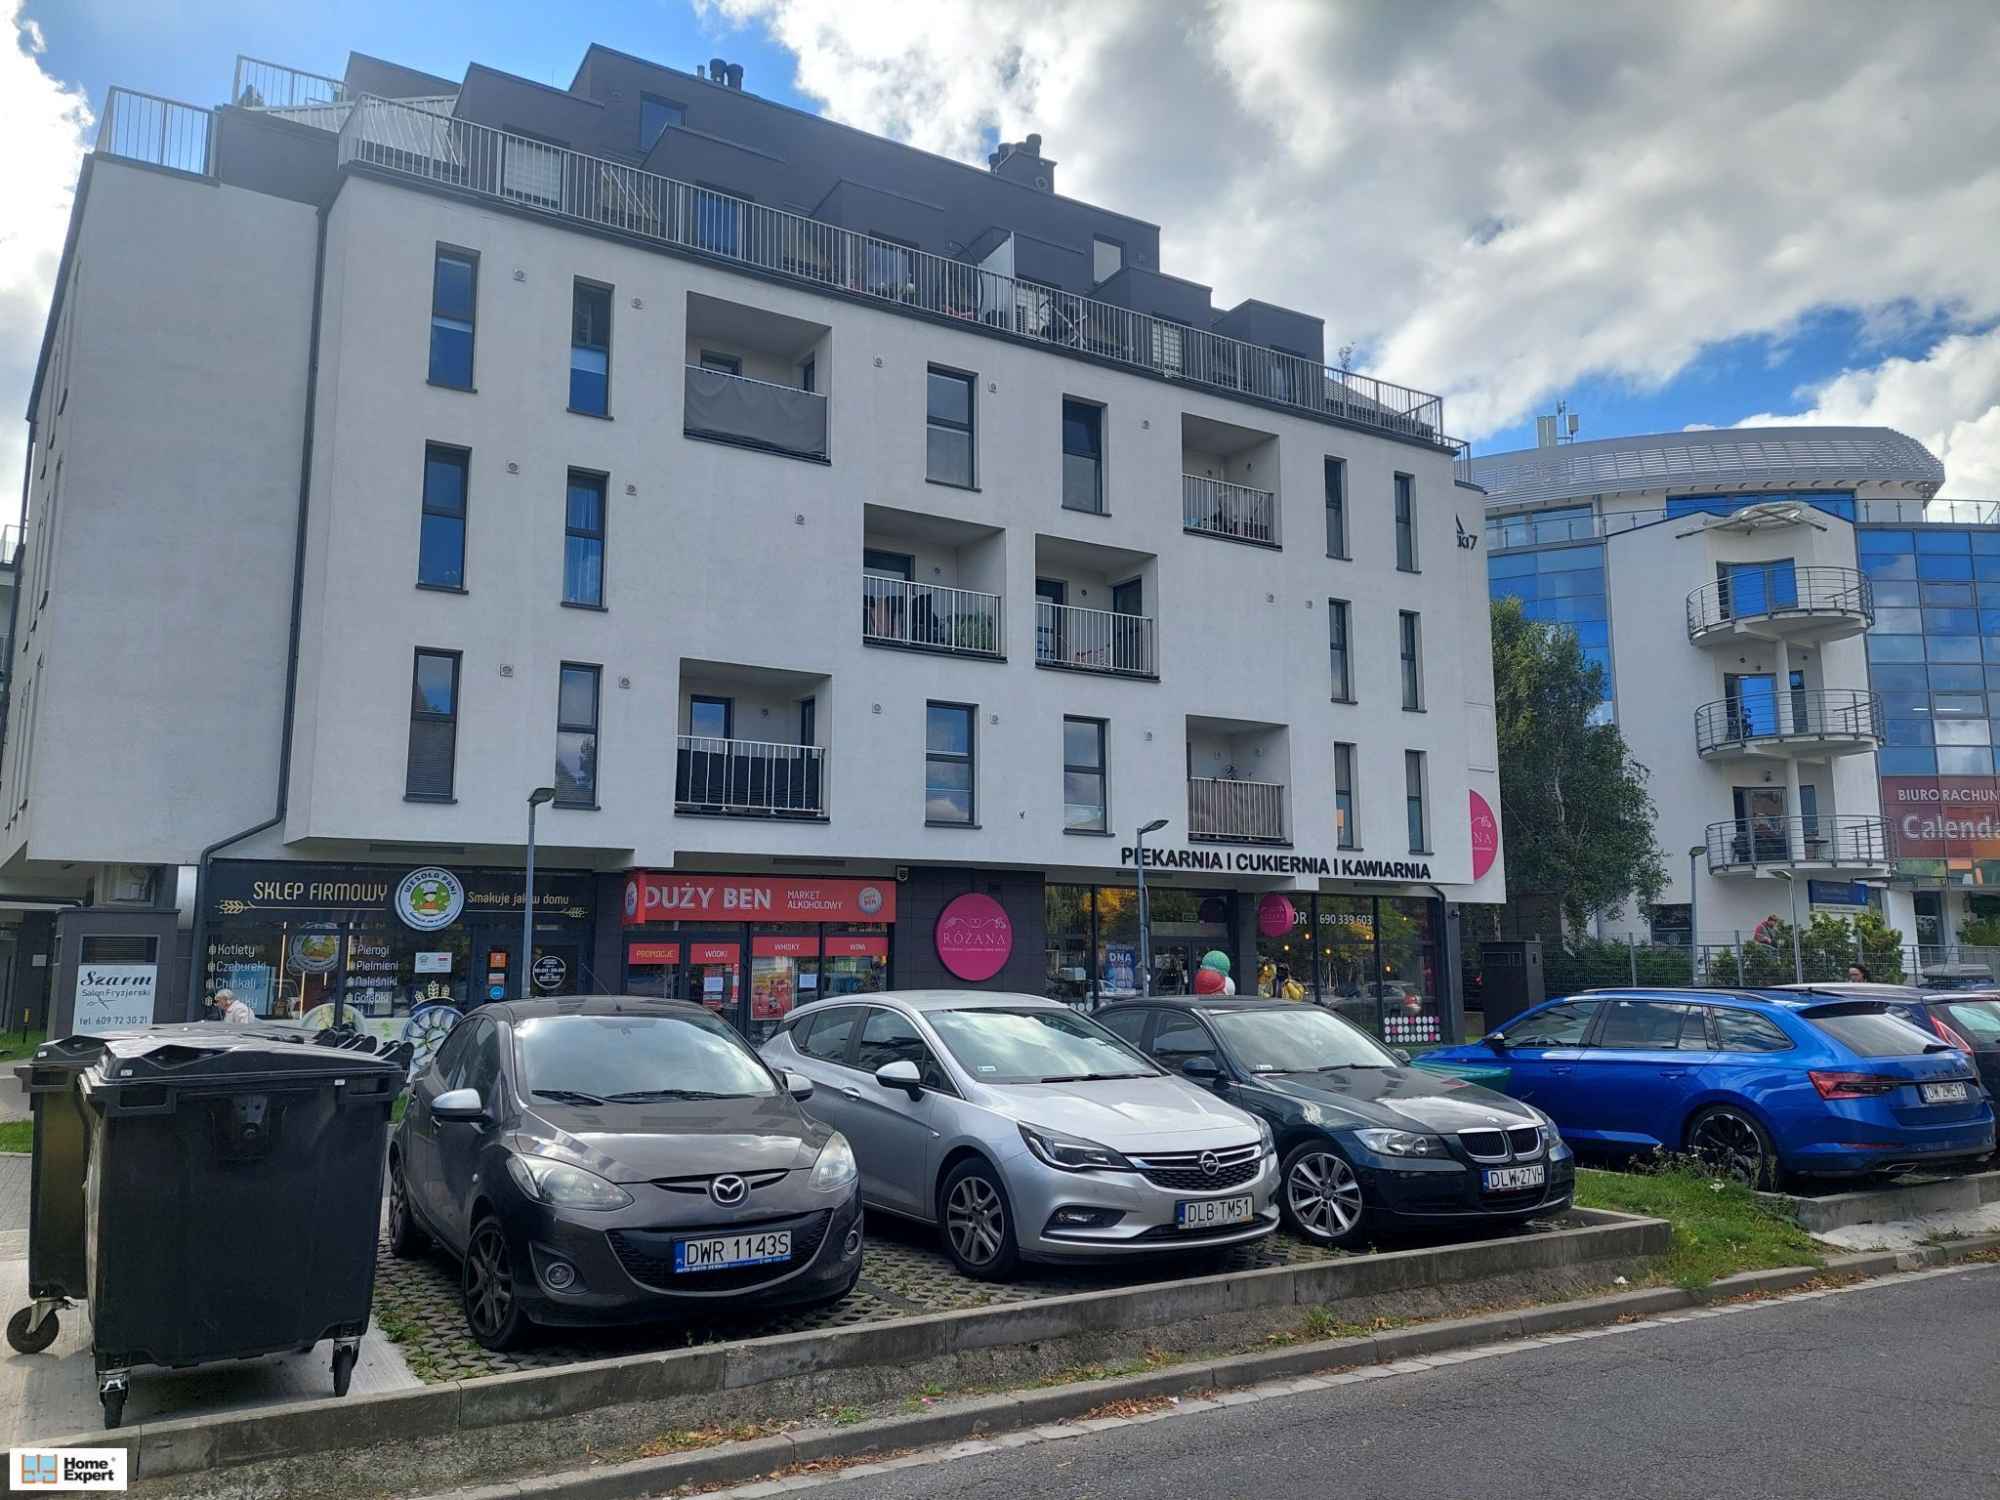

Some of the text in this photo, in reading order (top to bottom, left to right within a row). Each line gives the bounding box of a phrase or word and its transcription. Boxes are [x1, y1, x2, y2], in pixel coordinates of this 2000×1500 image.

[1897, 789, 2000, 801] BIURO RACHUN
[1121, 847, 1223, 870] PIEKARNIA
[1236, 853, 1330, 875] CUKIERNIA
[1342, 859, 1432, 880] KAWIARNIA
[253, 881, 388, 902] SKLEP FIRMOWY
[468, 891, 510, 906] Smakuje
[543, 893, 569, 905] domu
[644, 882, 714, 910] DUŻY
[723, 887, 771, 910] BEN
[787, 889, 820, 900] MARKET
[787, 899, 842, 911] ALKOHOLOWY
[1319, 913, 1373, 927] 690 339 603
[217, 944, 255, 958] Kotlety
[357, 944, 390, 957] Pierogi
[636, 950, 674, 958] PROMOCJE
[774, 943, 800, 951] WHISKY
[1109, 952, 1132, 962] DNA
[356, 960, 399, 971] Pielmieni
[80, 970, 152, 986] Szarm
[96, 1016, 112, 1025] 609
[1490, 1171, 1517, 1187] DLW
[1188, 1199, 1249, 1222] DLB TM51
[687, 1234, 789, 1265] DWR 1143S
